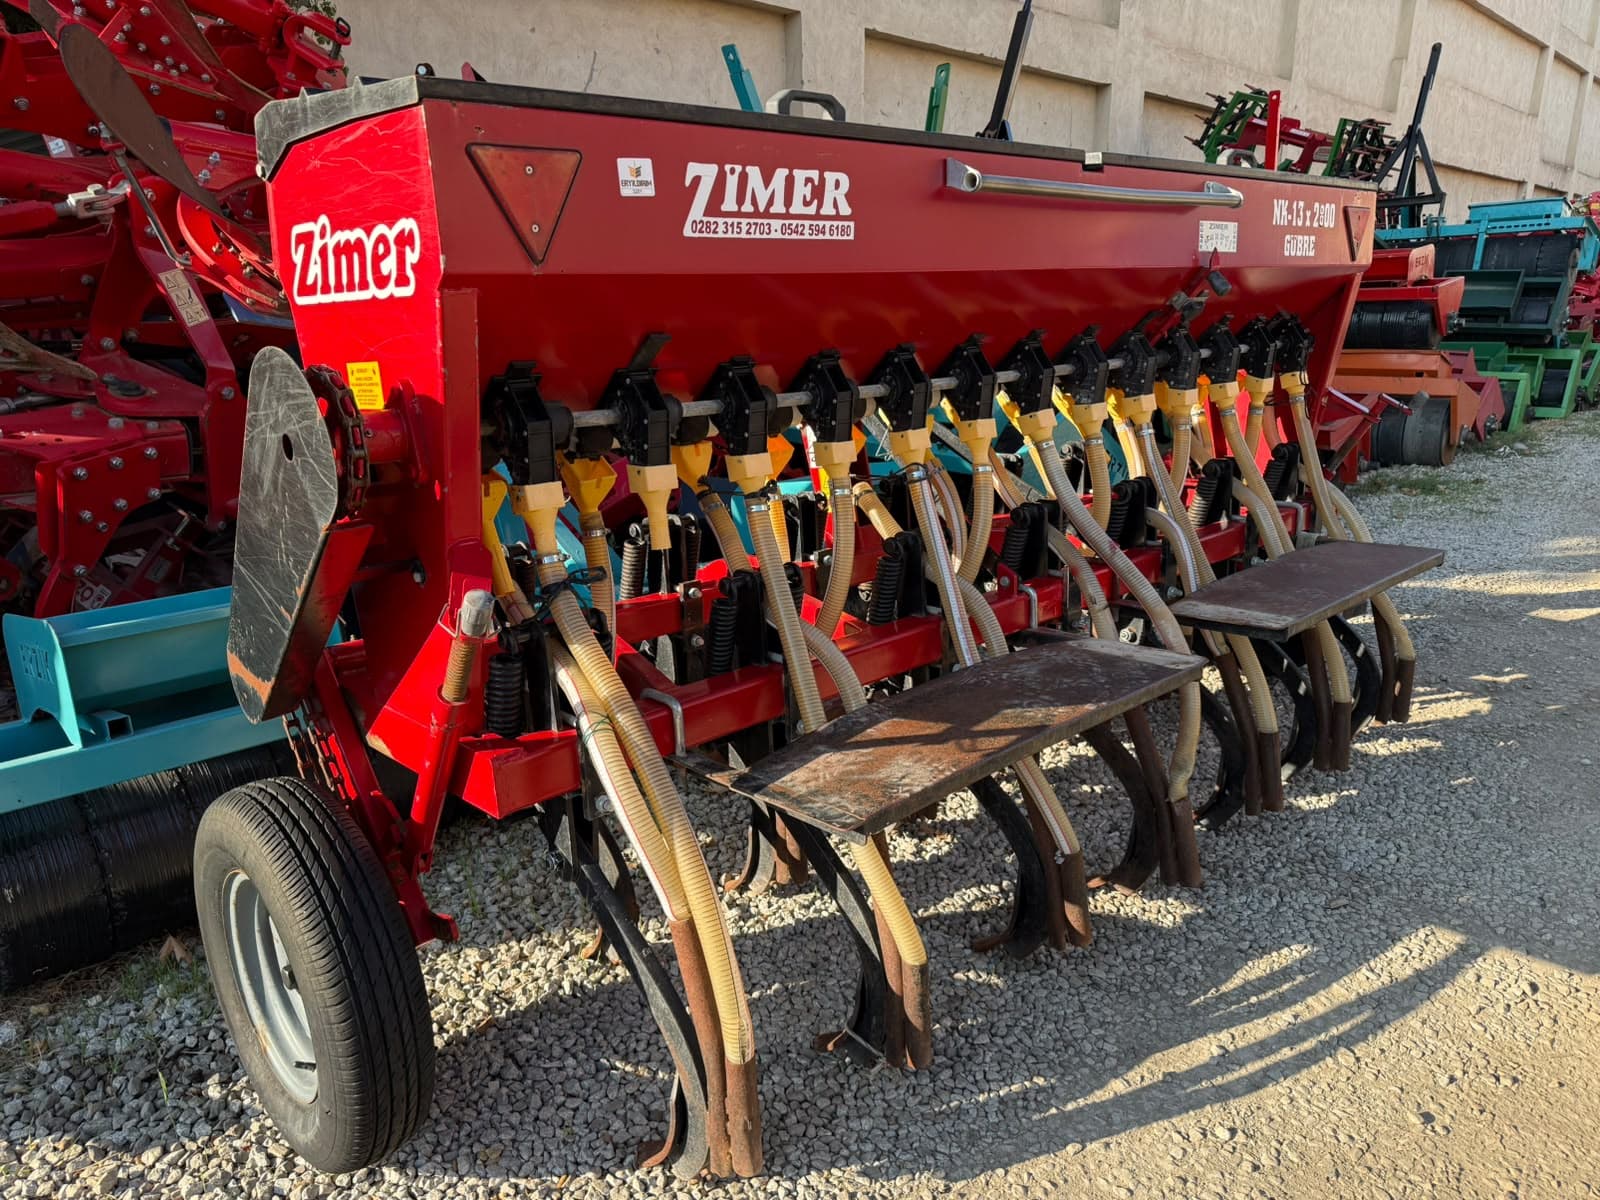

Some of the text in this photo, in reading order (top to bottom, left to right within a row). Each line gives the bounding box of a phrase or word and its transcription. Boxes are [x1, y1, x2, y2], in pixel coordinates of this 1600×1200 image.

[691, 220, 719, 234] 0282
[722, 221, 742, 235] 315
[745, 221, 772, 236] 2703
[780, 223, 805, 237] 0542
[808, 224, 826, 237] 594
[828, 224, 852, 238] 6180
[291, 214, 420, 306] Zimer
